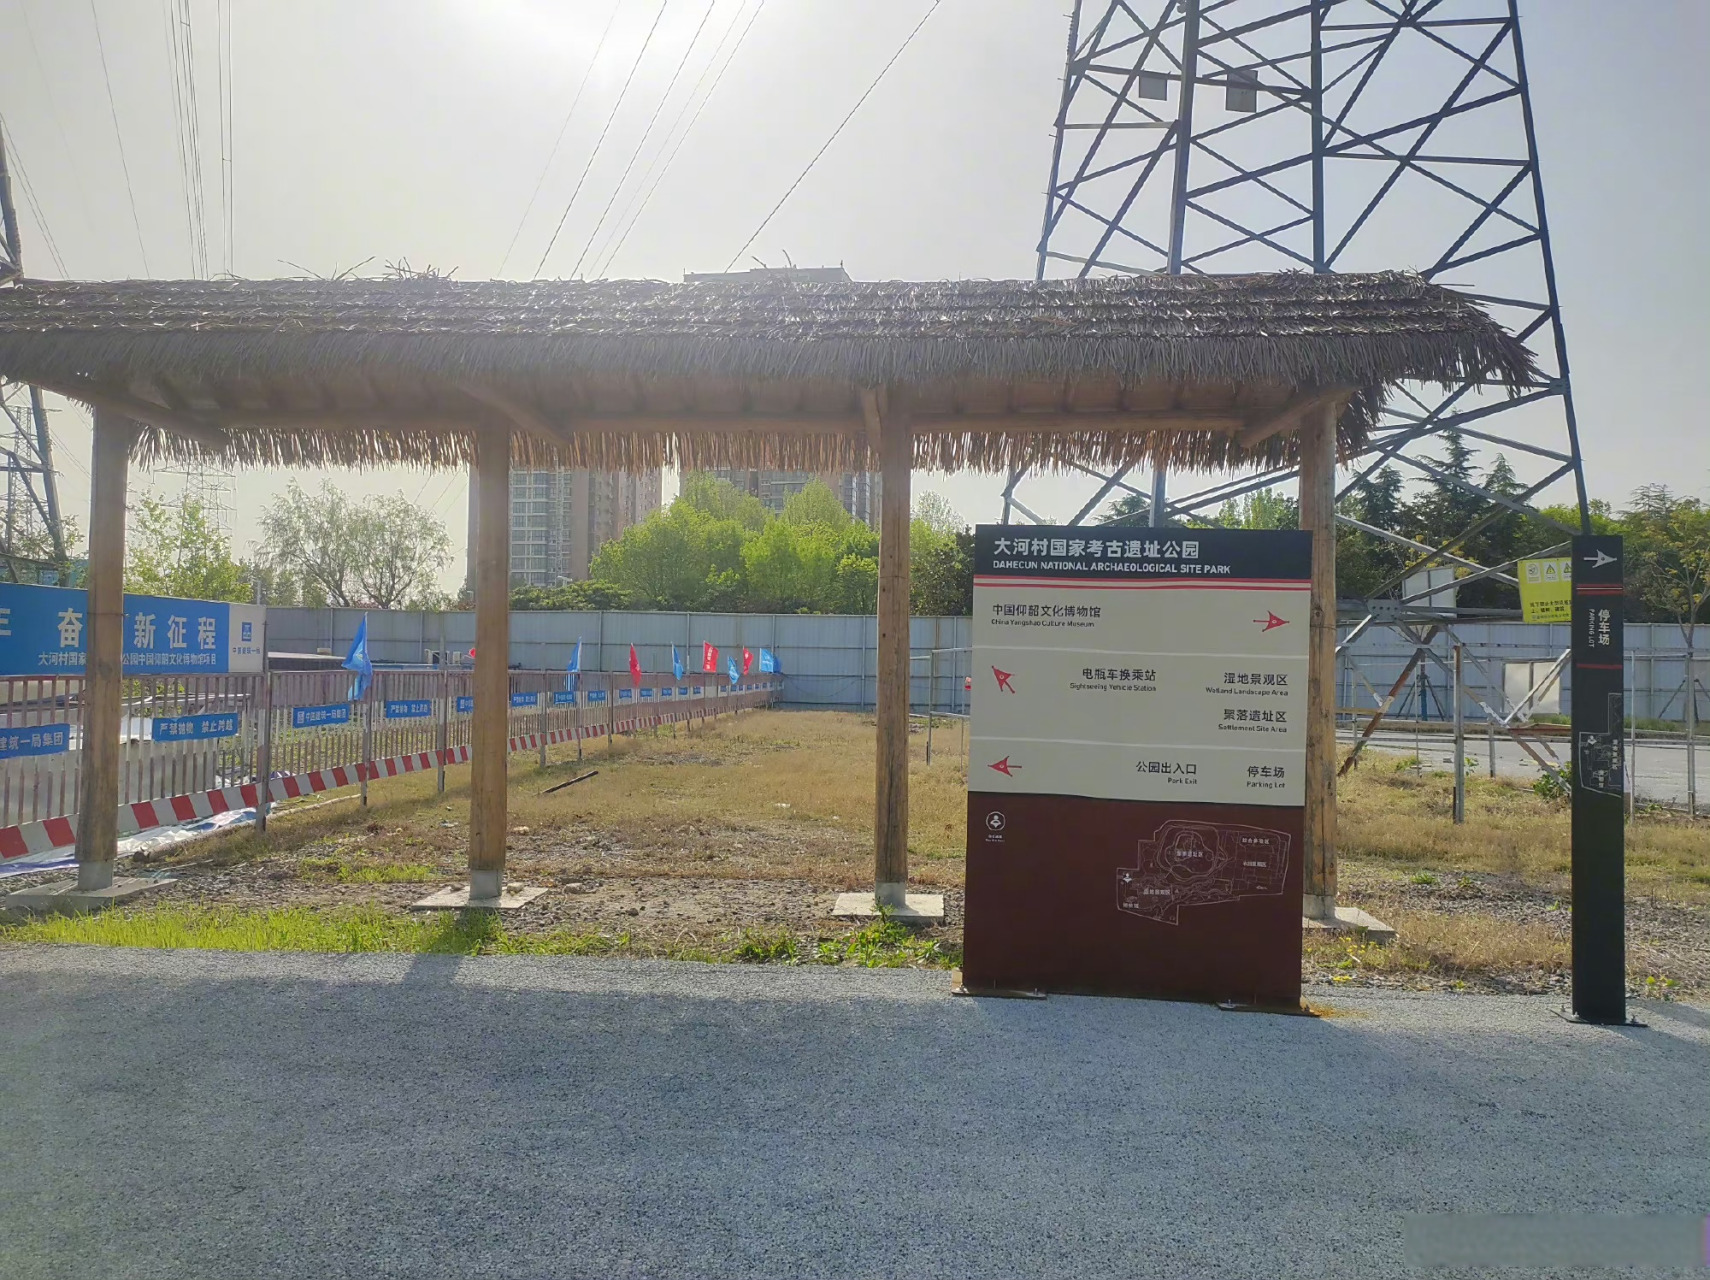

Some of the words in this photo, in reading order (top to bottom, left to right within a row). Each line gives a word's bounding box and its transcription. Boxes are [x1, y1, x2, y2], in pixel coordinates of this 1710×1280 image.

[993, 537, 1199, 559] 大河村国家考古遗址公园
[993, 560, 1038, 569] DAHECUN
[1041, 561, 1088, 571] NATIONAL
[1090, 562, 1178, 573] ARCHAEOLOGICAL
[1180, 564, 1202, 574] SITE
[1204, 565, 1231, 574] PARK
[992, 603, 1101, 618] 中国仰韶文化博物馆
[1597, 609, 1611, 646] 停车场
[1082, 668, 1156, 681] 电瓶车换乘站
[1223, 672, 1288, 686] 湿地景观区
[1069, 682, 1107, 691] Sightseeing
[1133, 684, 1156, 692] Station
[1234, 688, 1270, 697] Landscape
[1271, 689, 1289, 697] Area
[1223, 708, 1287, 723] 聚落遗址区
[1218, 723, 1255, 732] Settlement
[1135, 760, 1197, 775] 公园出入口
[1247, 765, 1285, 779] 停车场
[1246, 781, 1273, 789] Parking
